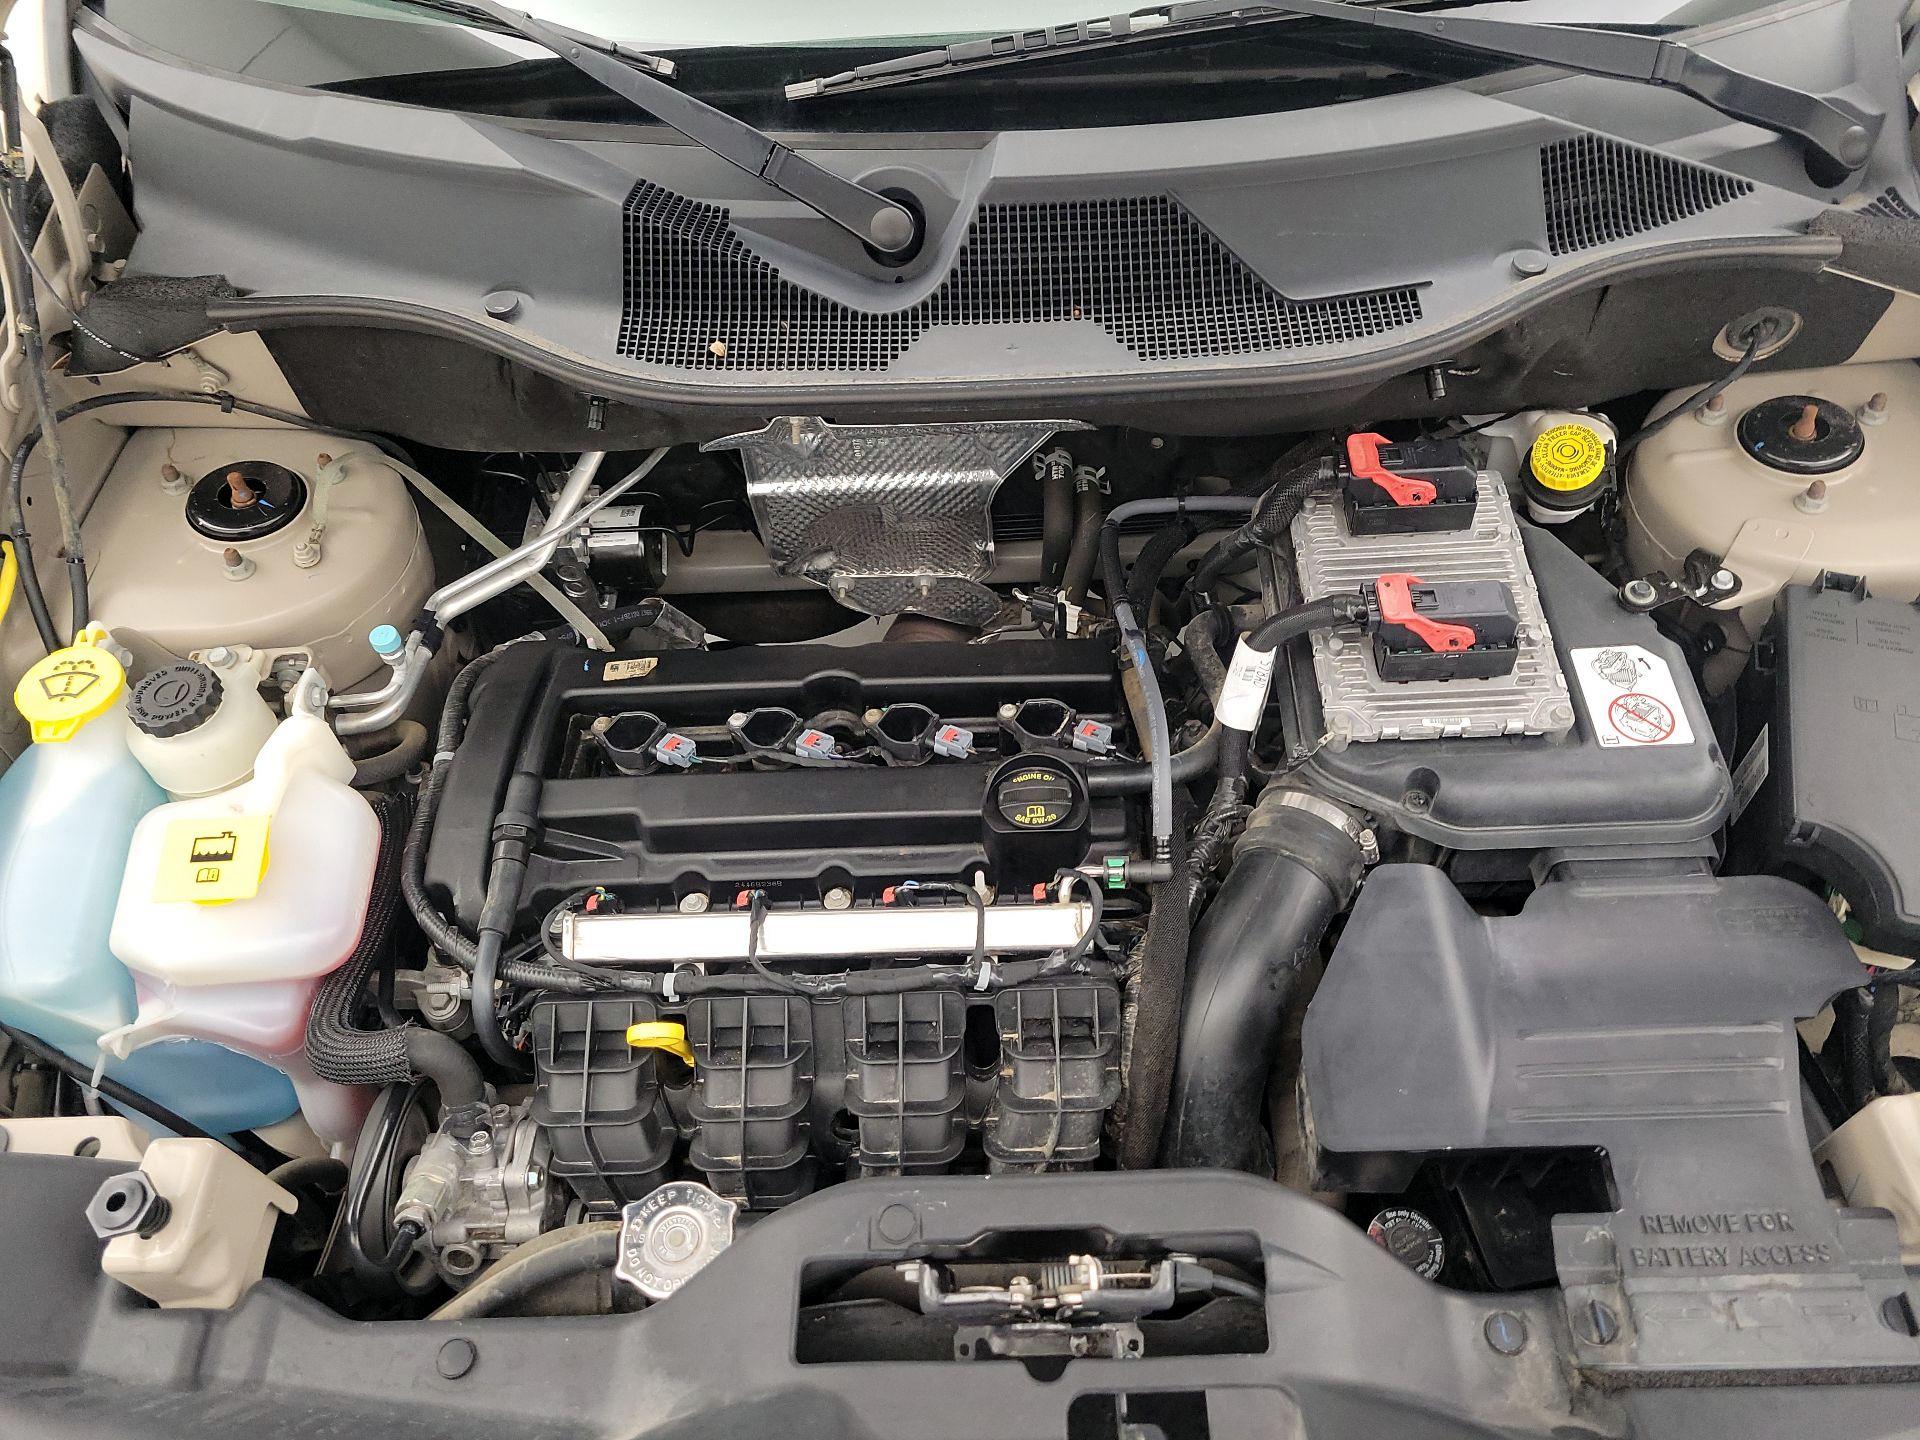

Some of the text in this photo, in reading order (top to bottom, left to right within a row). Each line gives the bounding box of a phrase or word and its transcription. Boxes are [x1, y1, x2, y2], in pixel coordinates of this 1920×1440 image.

[1012, 773, 1041, 782] ENGINE
[1014, 813, 1056, 824] SAE 5W-20
[639, 1190, 677, 1219] KEEP
[1410, 1212, 1432, 1230] Chrysler
[1640, 1212, 1796, 1234] REMOVE FOR
[1631, 1243, 1832, 1268] BATTERY ACCESS
